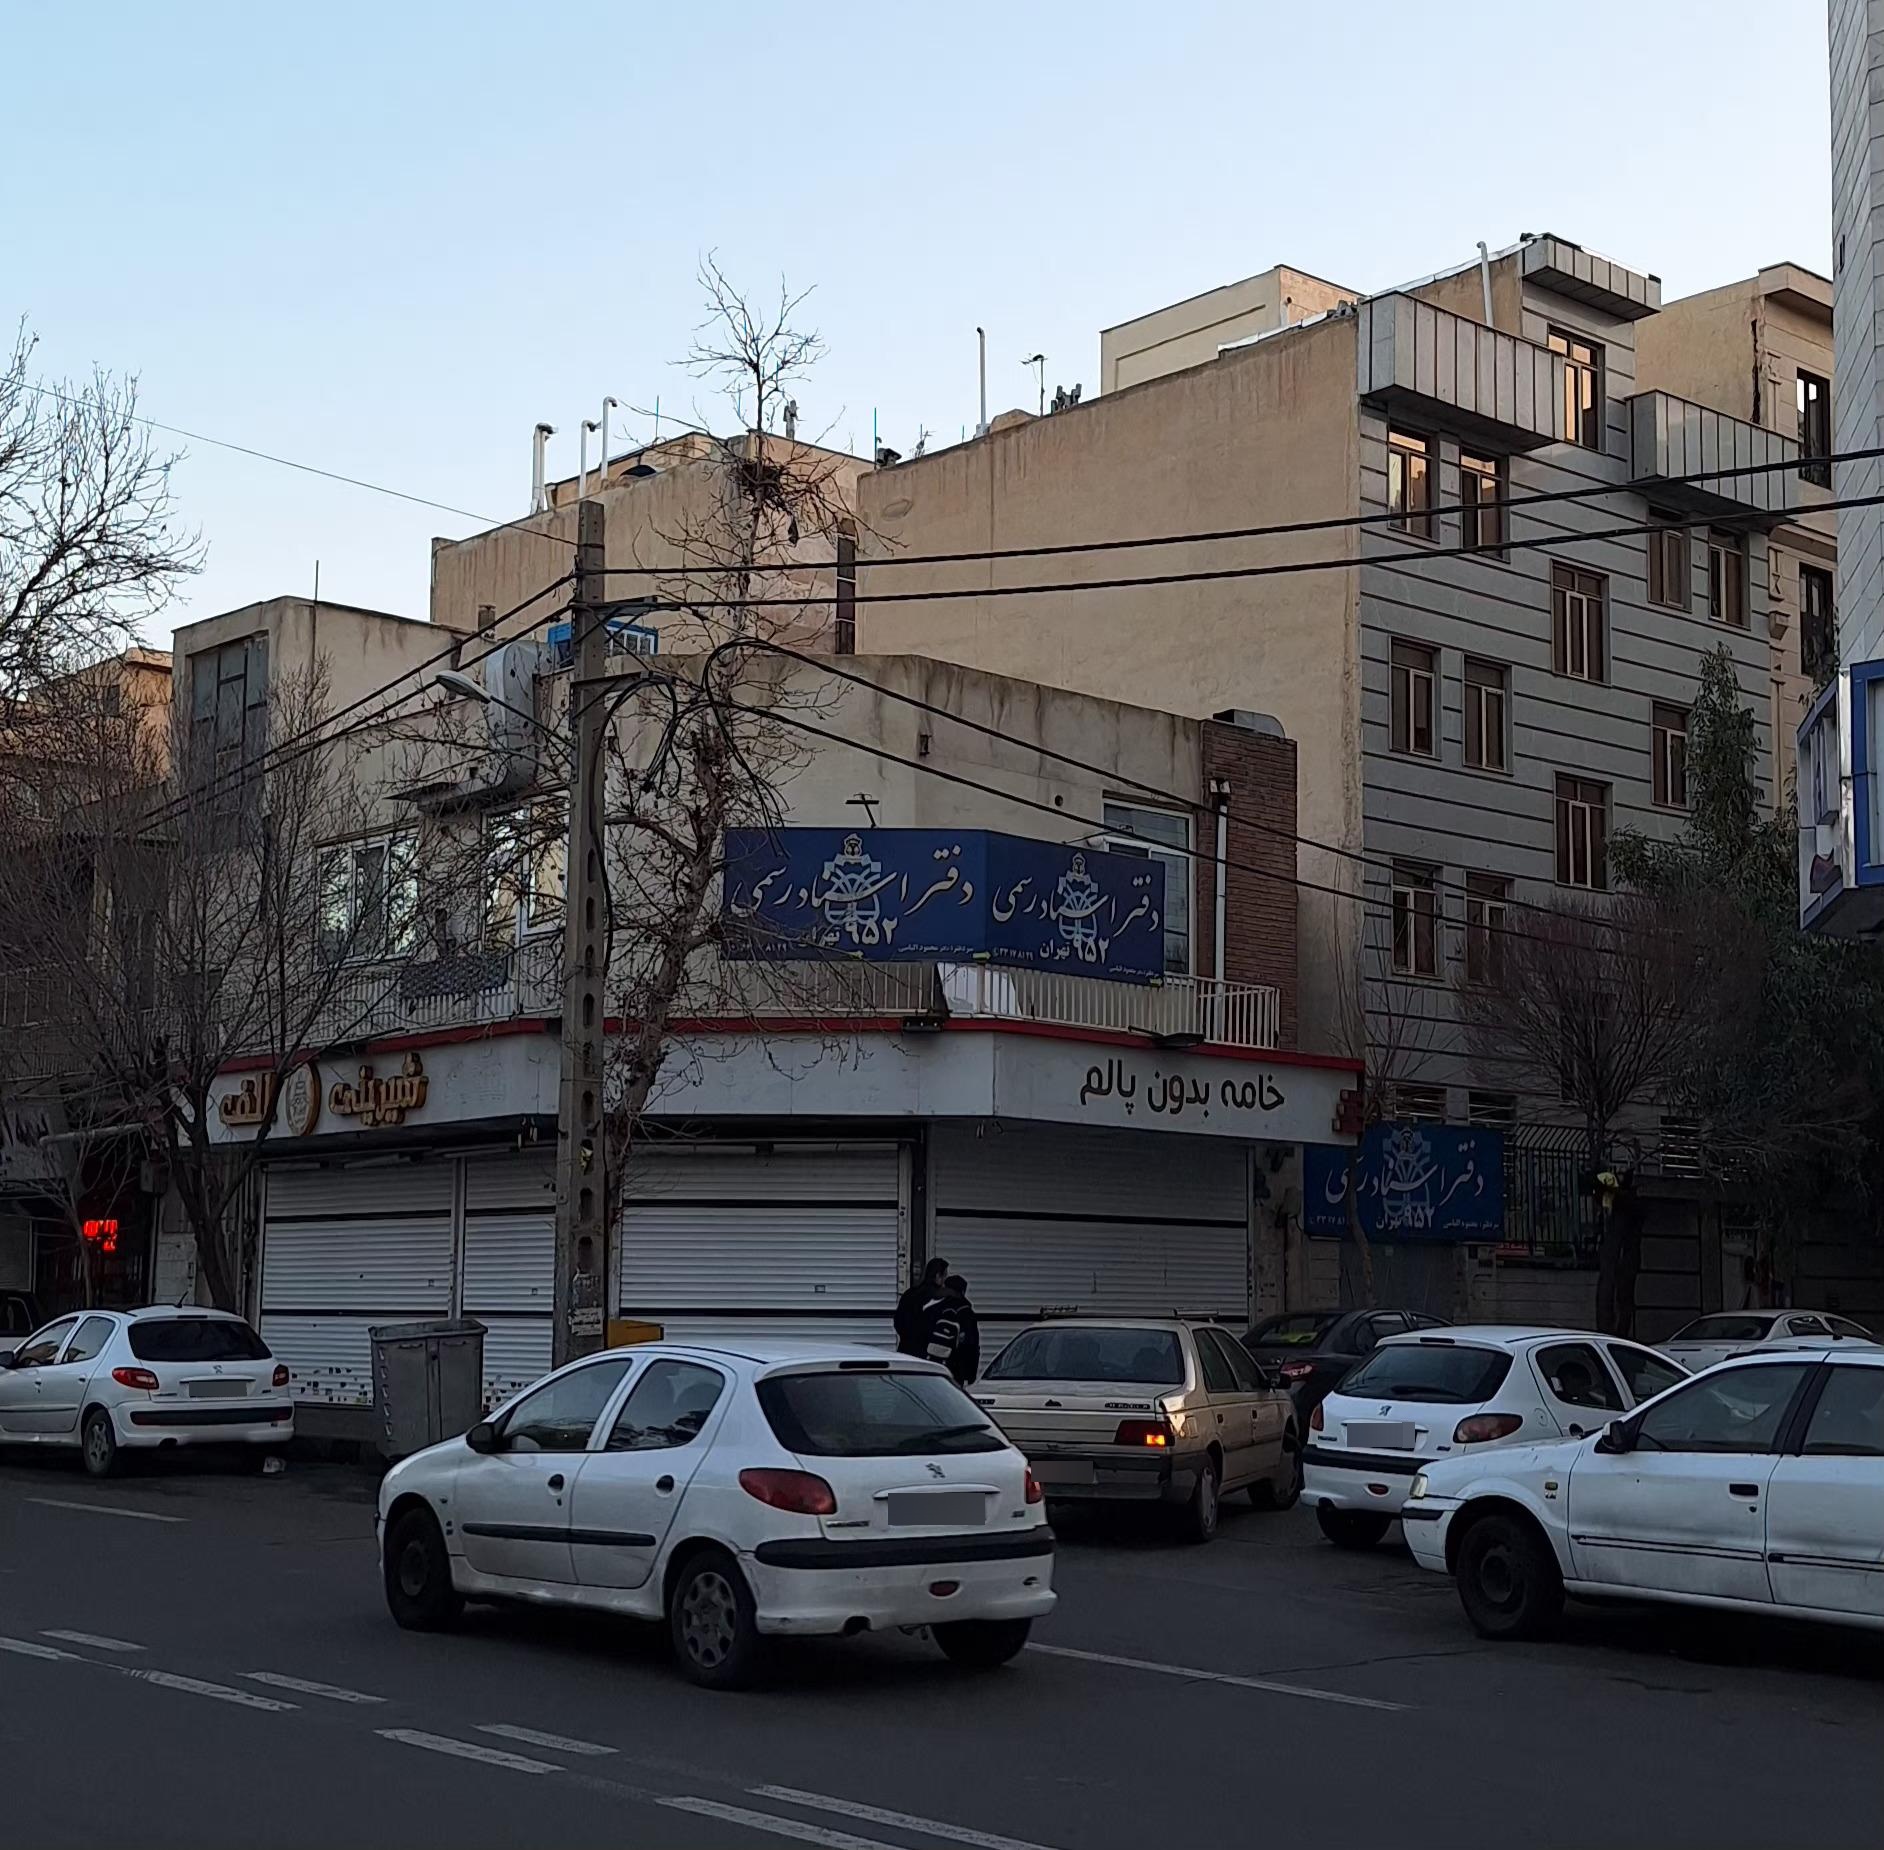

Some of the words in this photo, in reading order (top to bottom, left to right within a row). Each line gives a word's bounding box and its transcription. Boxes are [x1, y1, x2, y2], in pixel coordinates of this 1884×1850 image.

[730, 864, 794, 917] رسمی
[795, 871, 910, 910] اسناد
[903, 844, 976, 916] دفتر
[992, 875, 1038, 922] رسمی
[1037, 888, 1117, 926] اسناد
[1112, 874, 1160, 938] دفتر
[845, 916, 898, 945] ۹۵۲
[1039, 937, 1072, 960] تهران
[1072, 936, 1110, 964] ۹۵۲
[219, 1071, 280, 1126] الف
[328, 1050, 430, 1127] شیرینی
[1079, 1058, 1137, 1116] پالم
[1146, 1070, 1212, 1118] بدون
[1220, 1073, 1286, 1112] خامه
[1370, 1159, 1446, 1198] اسناد
[1439, 1139, 1485, 1207] دفتر
